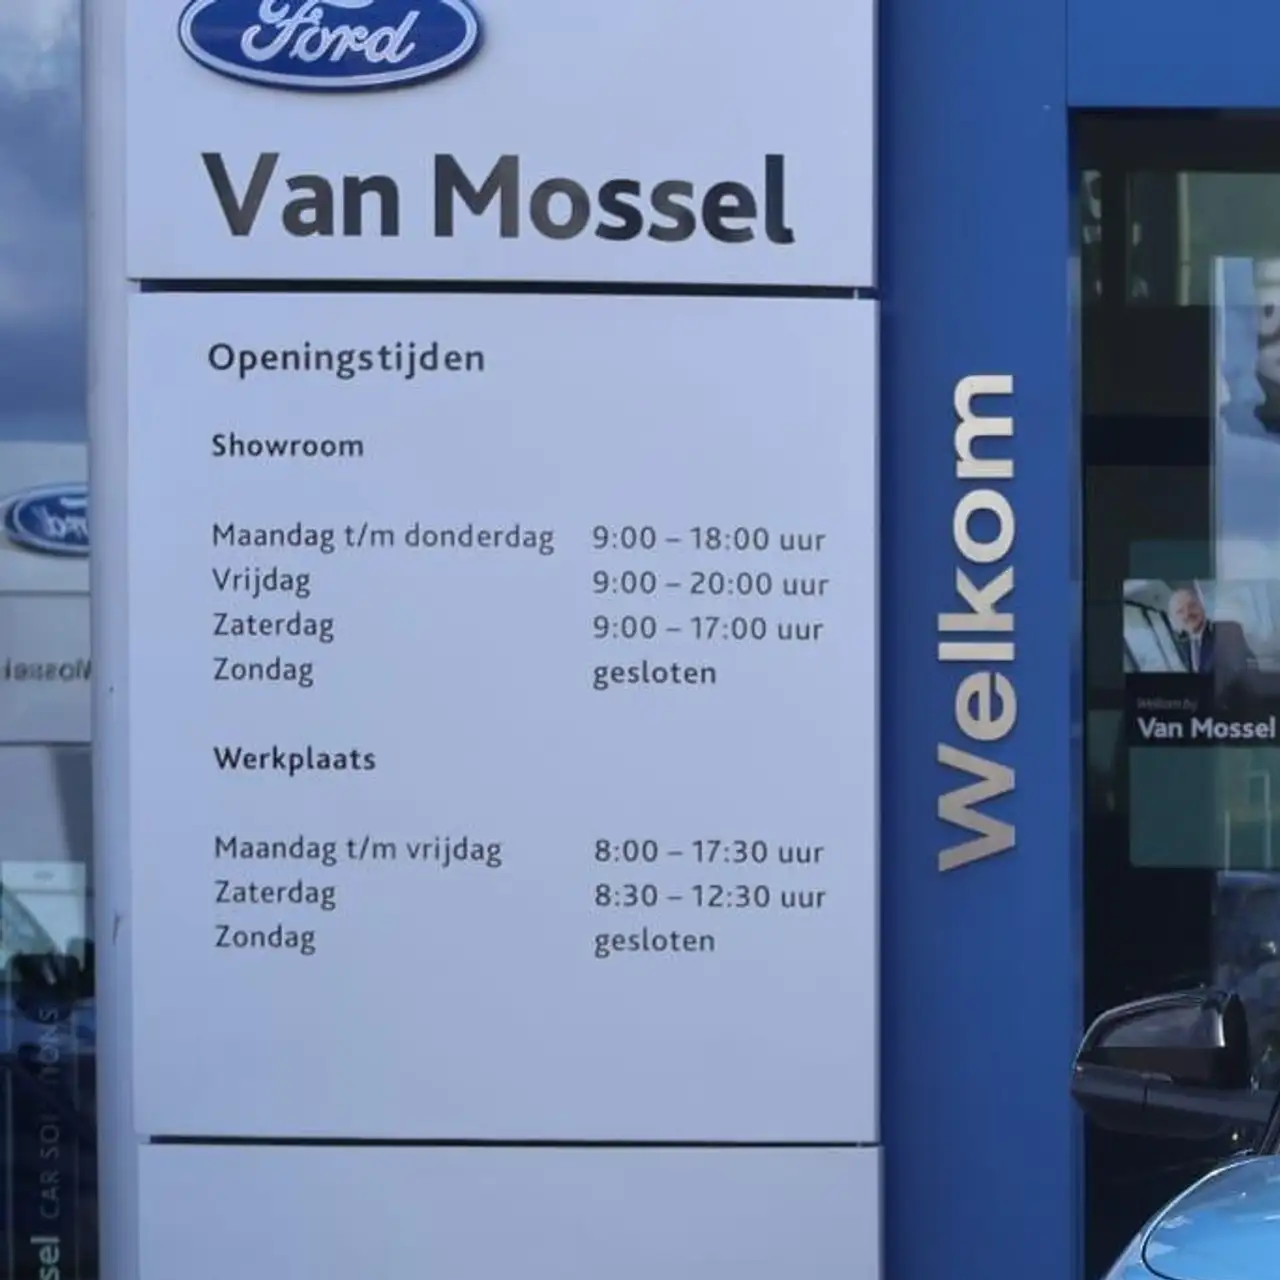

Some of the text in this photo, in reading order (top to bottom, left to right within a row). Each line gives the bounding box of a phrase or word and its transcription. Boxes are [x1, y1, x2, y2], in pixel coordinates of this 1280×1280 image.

[240, 0, 421, 63] Ford
[200, 152, 796, 245] Van Mossel
[208, 341, 484, 381] Openingstijden
[212, 431, 364, 458] Showroom
[212, 521, 335, 555] Maandag
[344, 522, 395, 548] t/m
[404, 521, 555, 556] donderdag
[592, 525, 657, 550] 9:00
[690, 526, 770, 551] 18:00
[779, 533, 826, 552] uur
[211, 566, 311, 600] Vrijdag
[593, 570, 657, 595] 9:00
[690, 571, 773, 596] 20:00
[782, 578, 830, 596] uur
[213, 610, 334, 644] Zaterdag
[593, 614, 657, 640] 9:00
[690, 616, 767, 641] 17:00
[777, 623, 824, 641] uur
[938, 373, 1017, 874] Welkom
[213, 656, 716, 691] Zondag gesloten
[1137, 716, 1276, 738] Van Mossel
[213, 745, 376, 778] Werkplaats
[214, 834, 338, 867] Maandag
[346, 835, 397, 861] t/m
[406, 835, 502, 869] vrijdag
[594, 839, 659, 863] 8:00
[692, 839, 768, 864] 17:30
[778, 846, 824, 864] uur
[215, 879, 336, 911] Zaterdag
[594, 883, 658, 908] 8:30
[692, 884, 771, 908] 12:30
[781, 891, 826, 909] uur
[215, 923, 715, 959] Zondag gesloten
[39, 1169, 61, 1220] CAR
